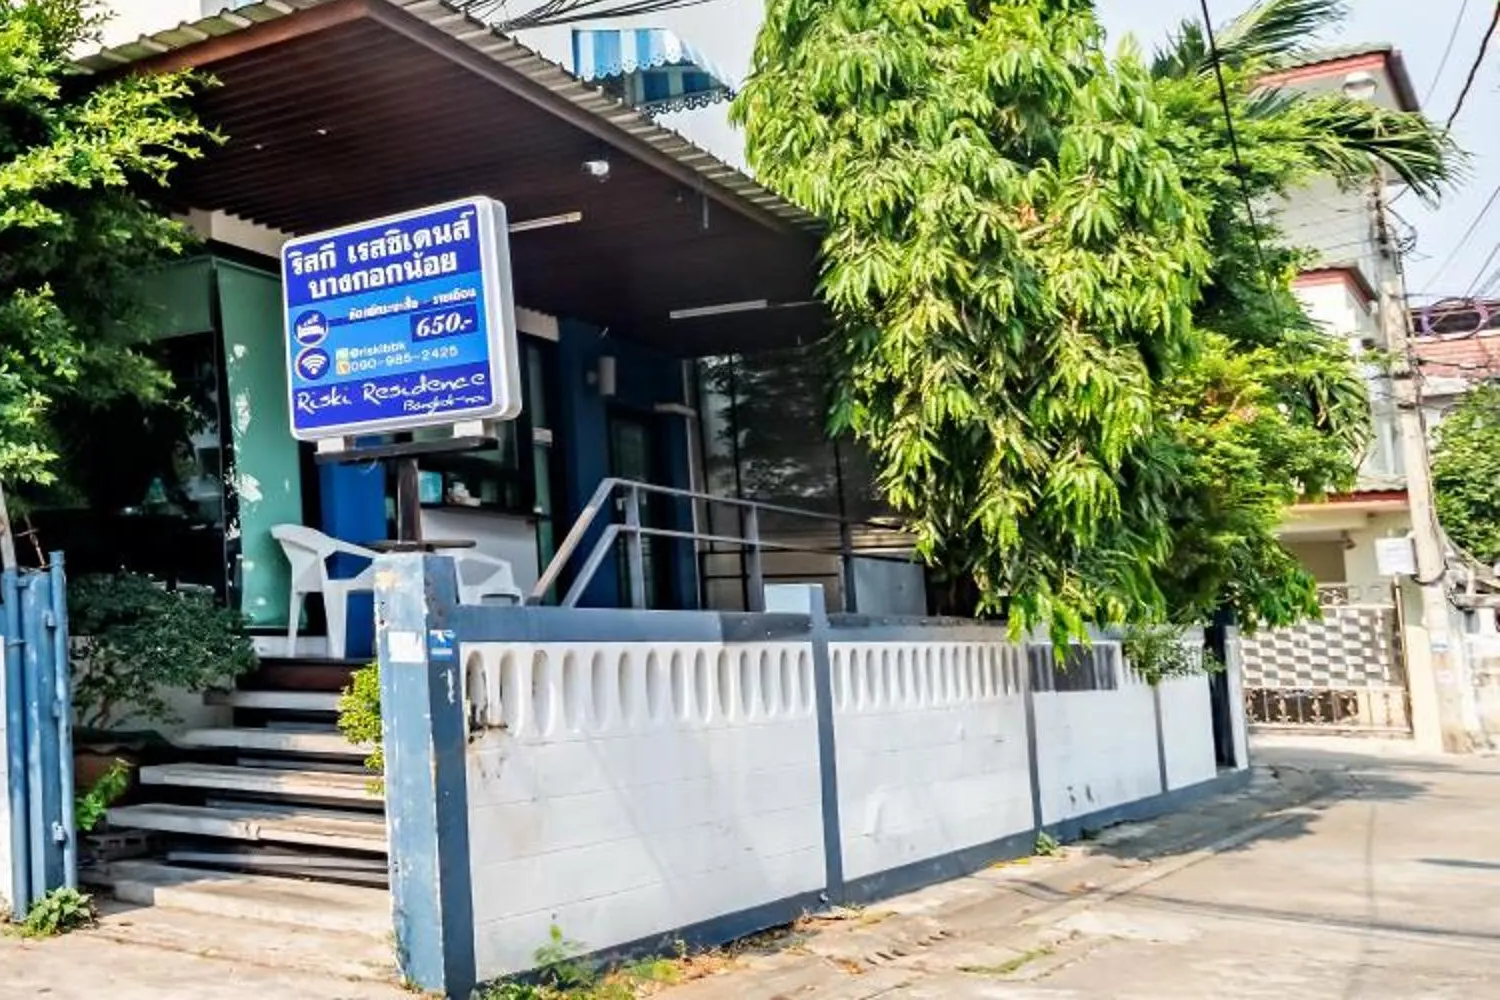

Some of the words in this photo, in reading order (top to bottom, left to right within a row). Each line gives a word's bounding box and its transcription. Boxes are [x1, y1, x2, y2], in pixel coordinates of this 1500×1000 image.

[308, 251, 457, 299] บางกอกน้อย
[416, 312, 473, 337] 650.-
[297, 386, 352, 415] Riski
[363, 372, 485, 405] Residence
